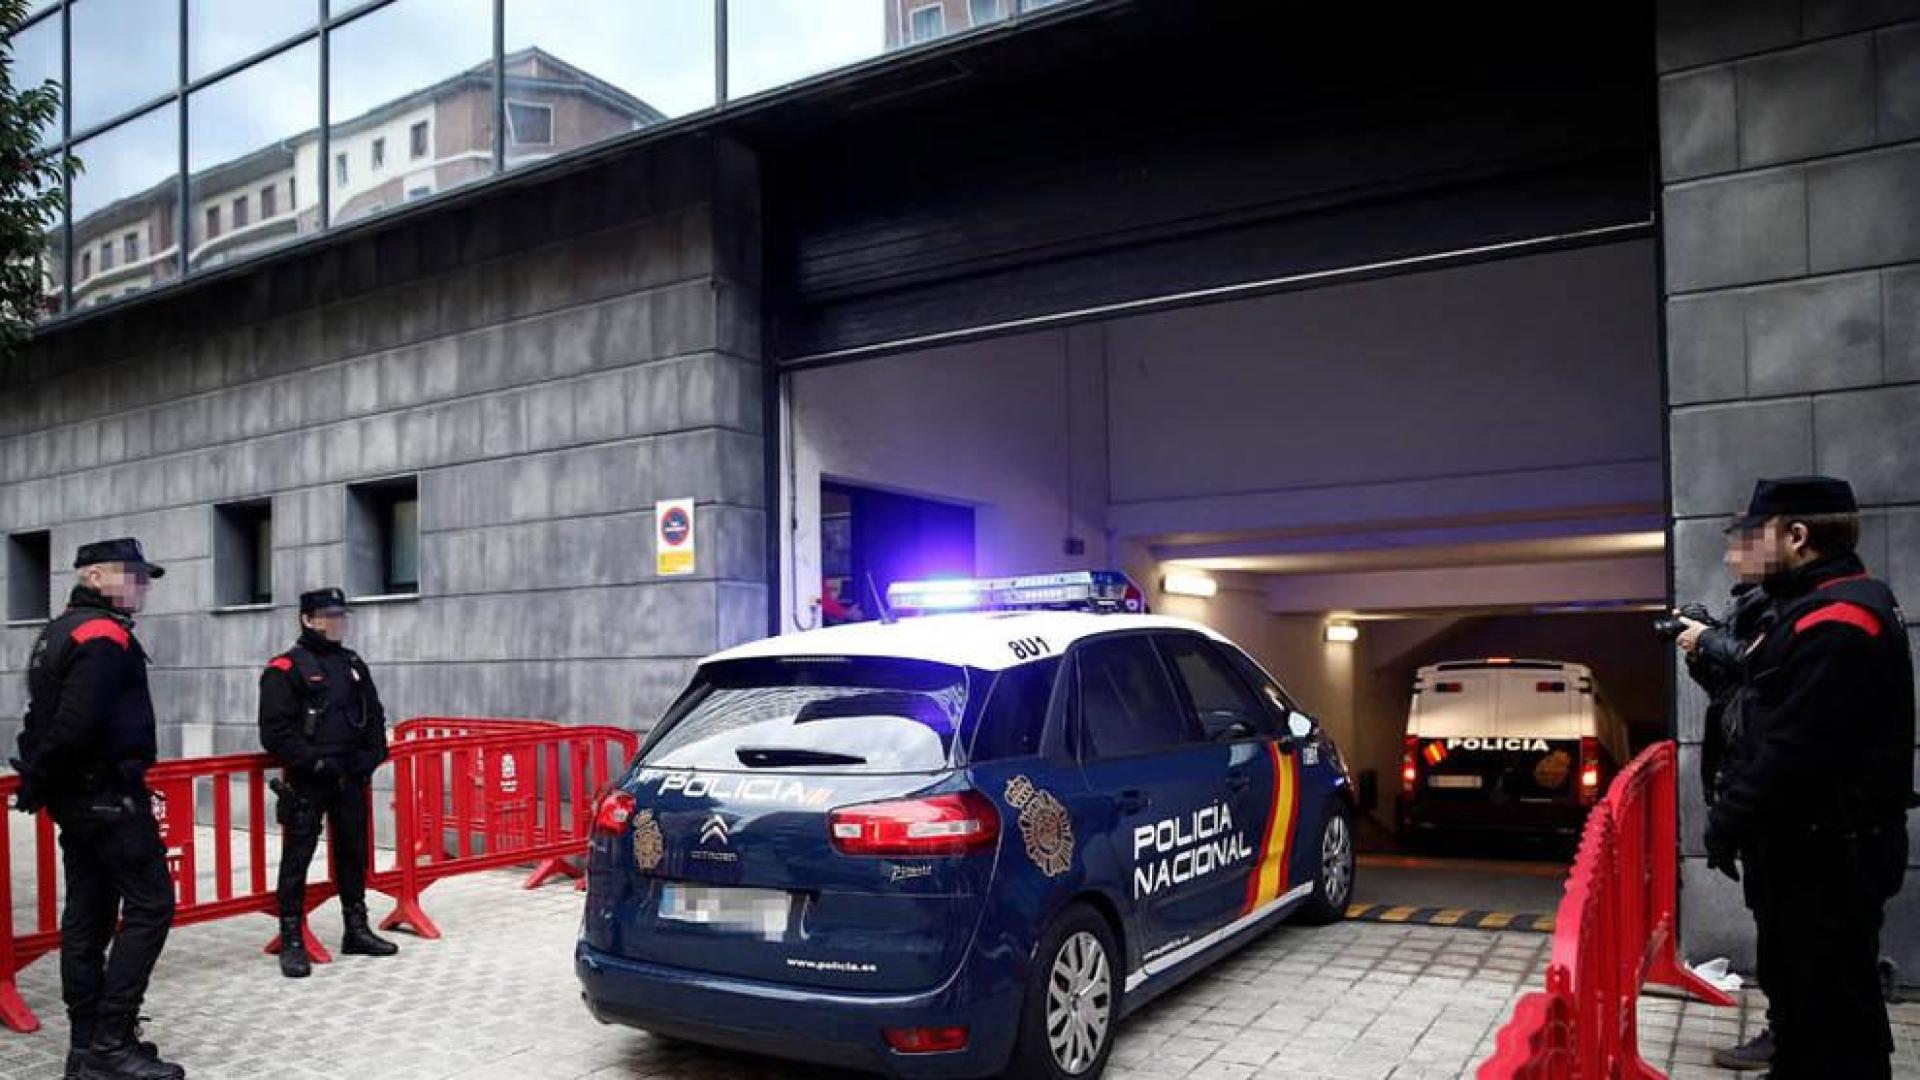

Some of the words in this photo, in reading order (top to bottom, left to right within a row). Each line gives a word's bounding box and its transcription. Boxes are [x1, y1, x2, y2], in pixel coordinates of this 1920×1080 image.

[1008, 636, 1051, 660] 8U1
[1447, 738, 1549, 751] POLICIA
[1134, 831, 1252, 901] NACIONAL
[787, 958, 877, 971] www.policia.es
